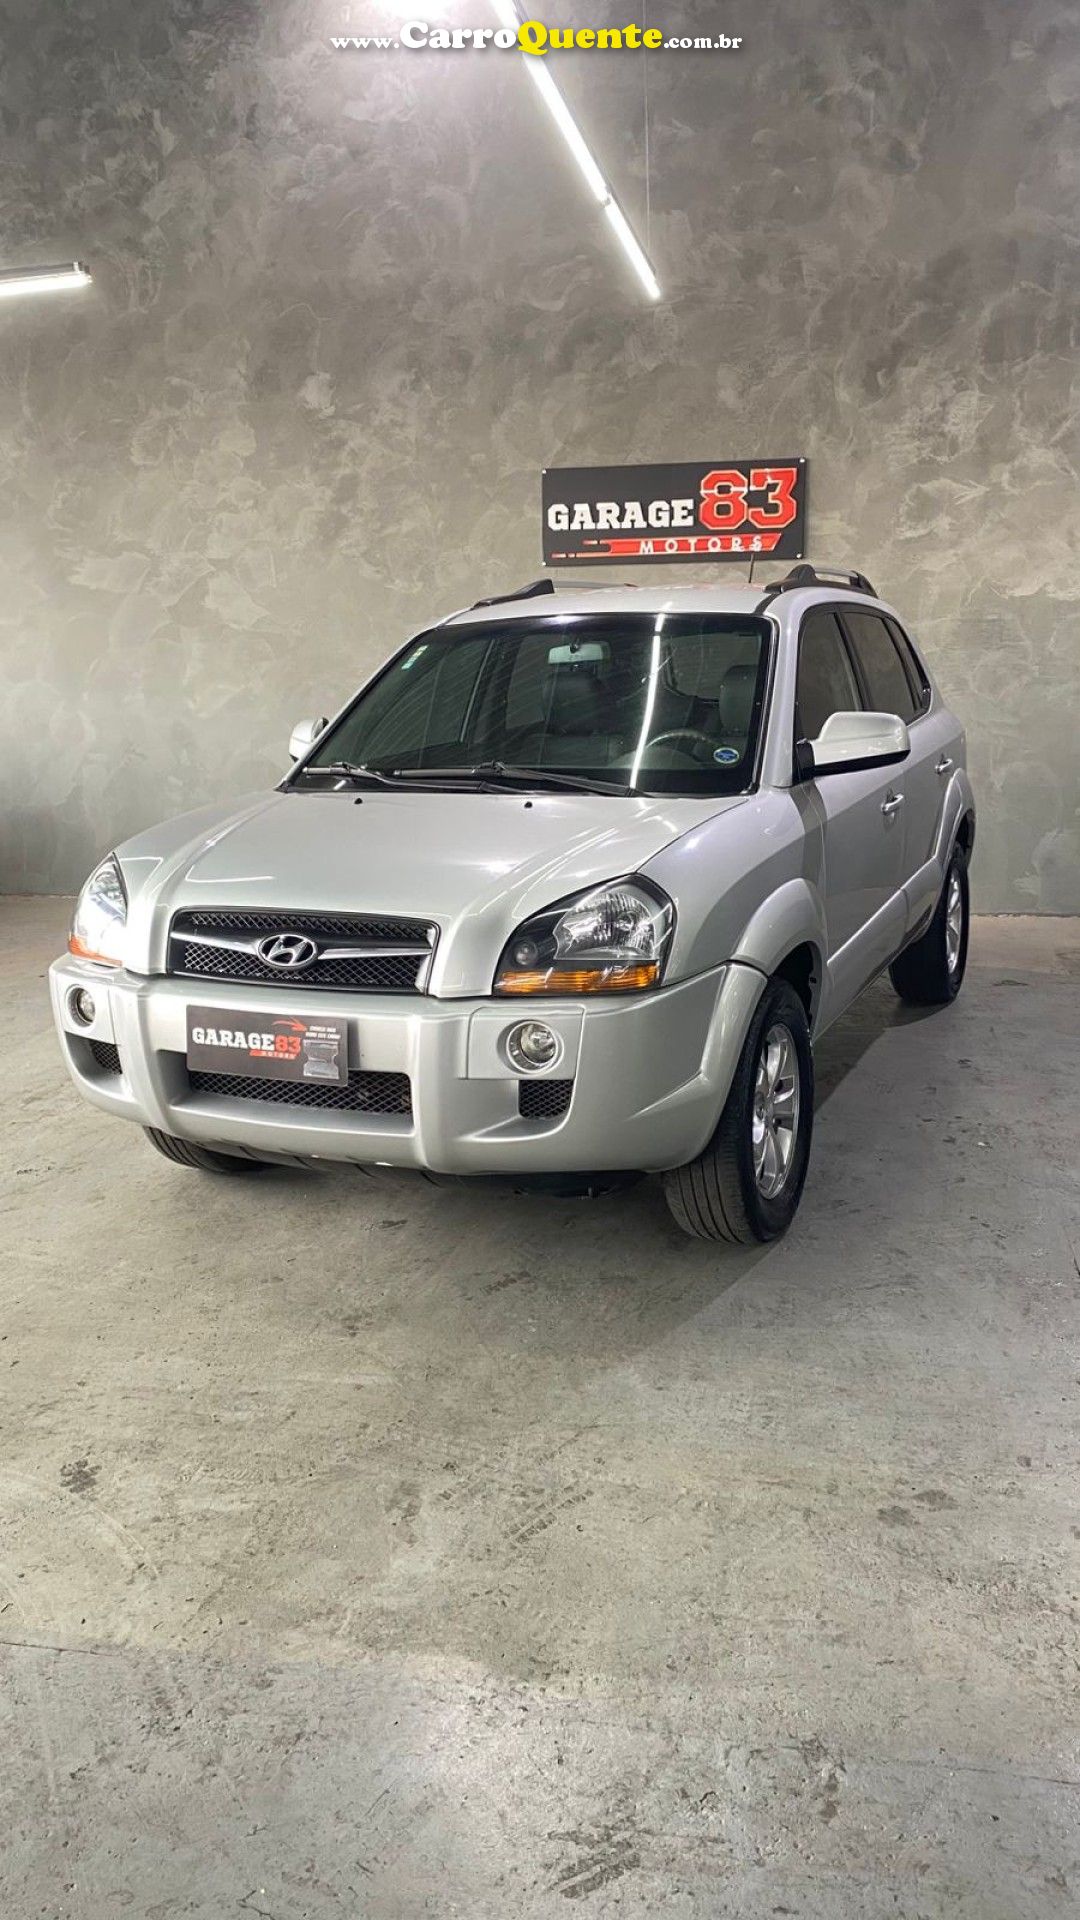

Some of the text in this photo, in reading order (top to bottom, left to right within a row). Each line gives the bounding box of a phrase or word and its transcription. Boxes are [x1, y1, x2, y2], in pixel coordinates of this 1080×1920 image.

[547, 467, 797, 531] GARAGE 83
[639, 535, 763, 554] MOTORS
